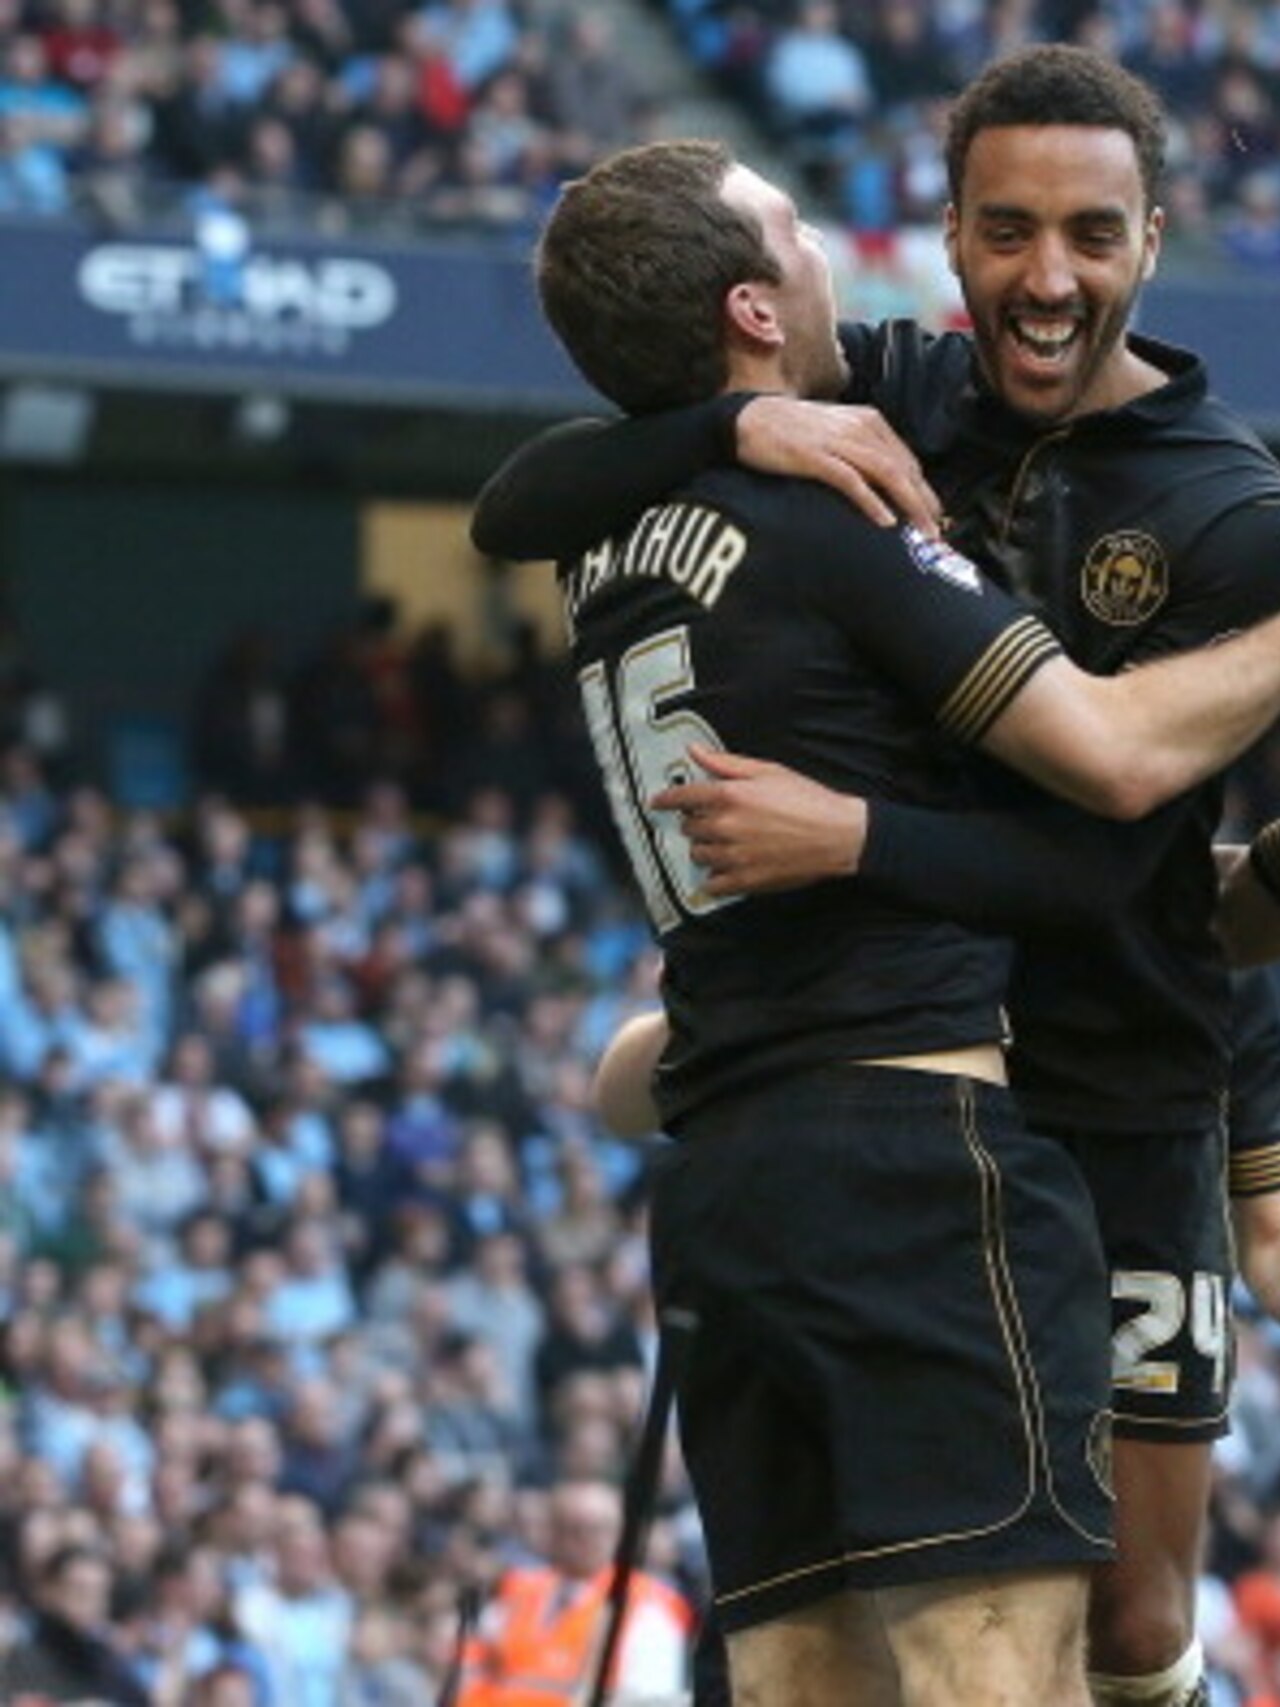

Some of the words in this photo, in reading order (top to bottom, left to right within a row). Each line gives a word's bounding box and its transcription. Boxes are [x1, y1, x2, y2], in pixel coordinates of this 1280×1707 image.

[78, 242, 396, 328] ETHAD
[577, 622, 750, 934] 16
[1110, 1268, 1226, 1393] 24
